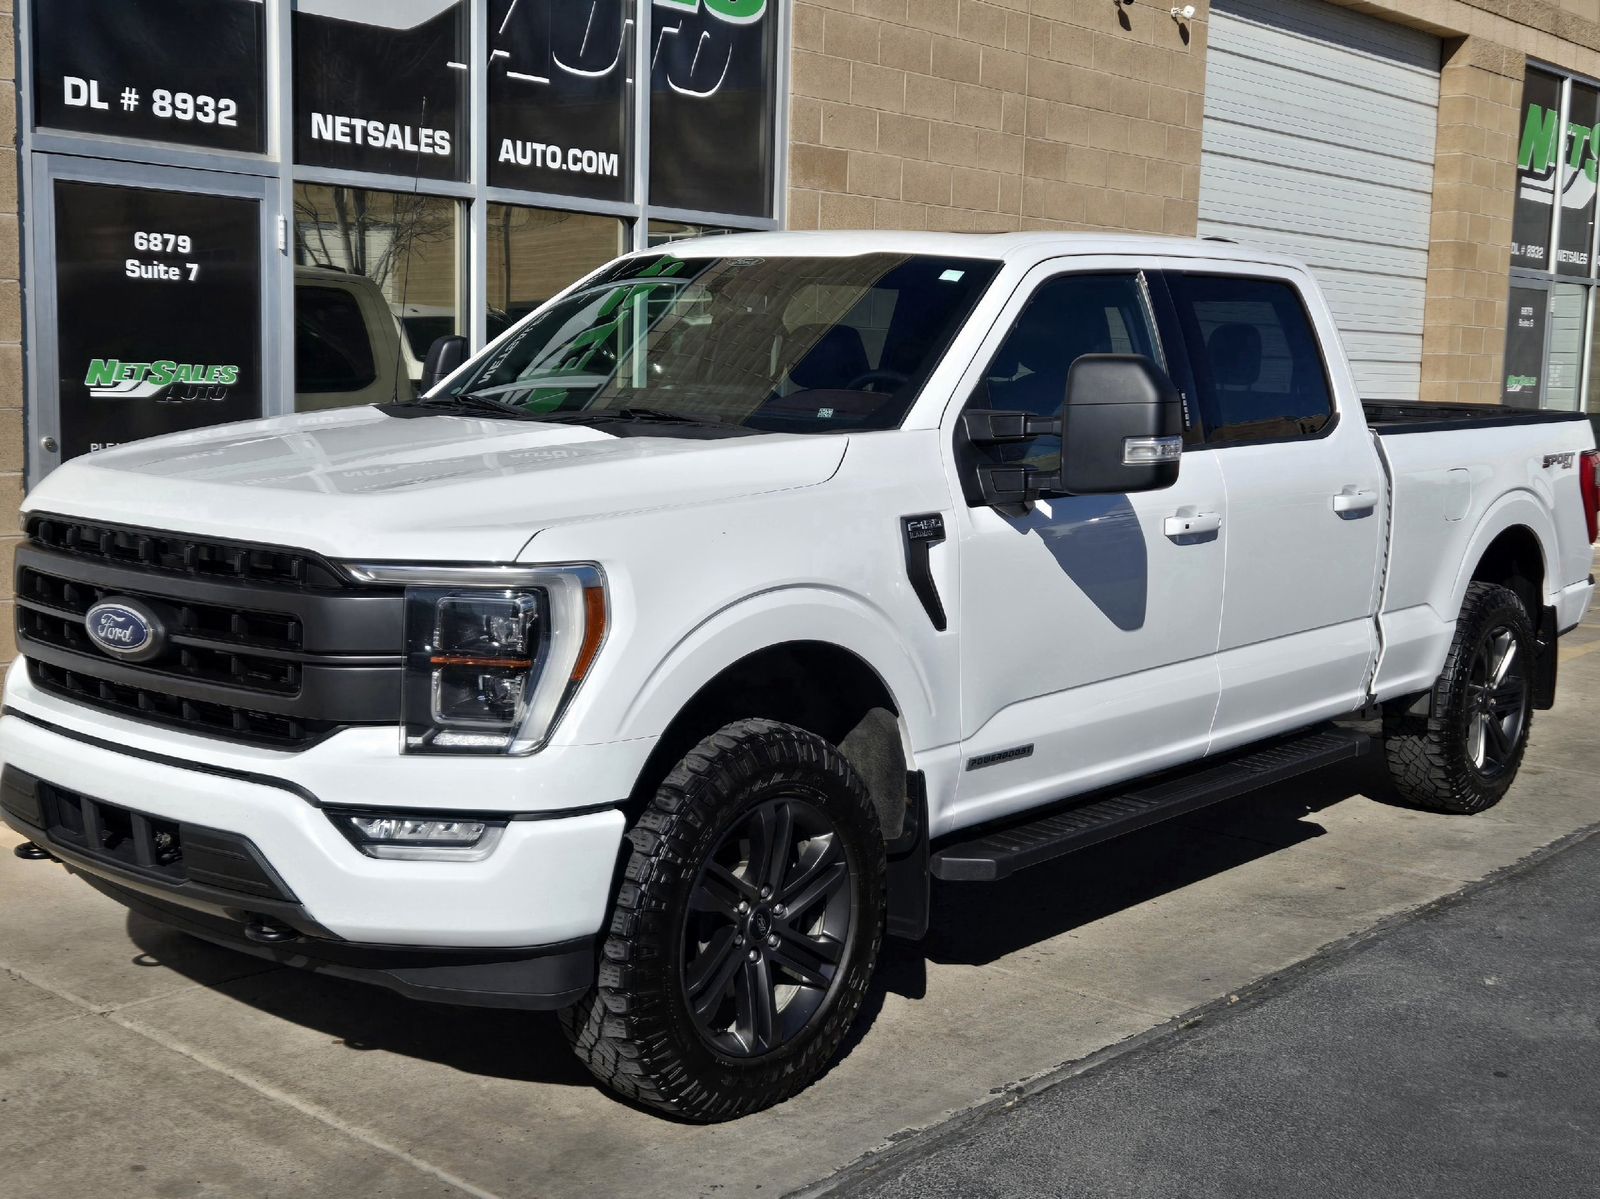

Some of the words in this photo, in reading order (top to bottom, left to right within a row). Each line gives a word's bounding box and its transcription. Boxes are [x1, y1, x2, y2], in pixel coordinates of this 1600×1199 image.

[63, 75, 109, 110] DL
[120, 86, 139, 111] #
[151, 88, 238, 127] 8932
[310, 112, 451, 156] NETSALES
[498, 138, 619, 177] AUTO.COM
[134, 231, 192, 253] 6879
[125, 258, 182, 280] Suite
[185, 263, 199, 281] 7
[97, 613, 133, 643] Ford
